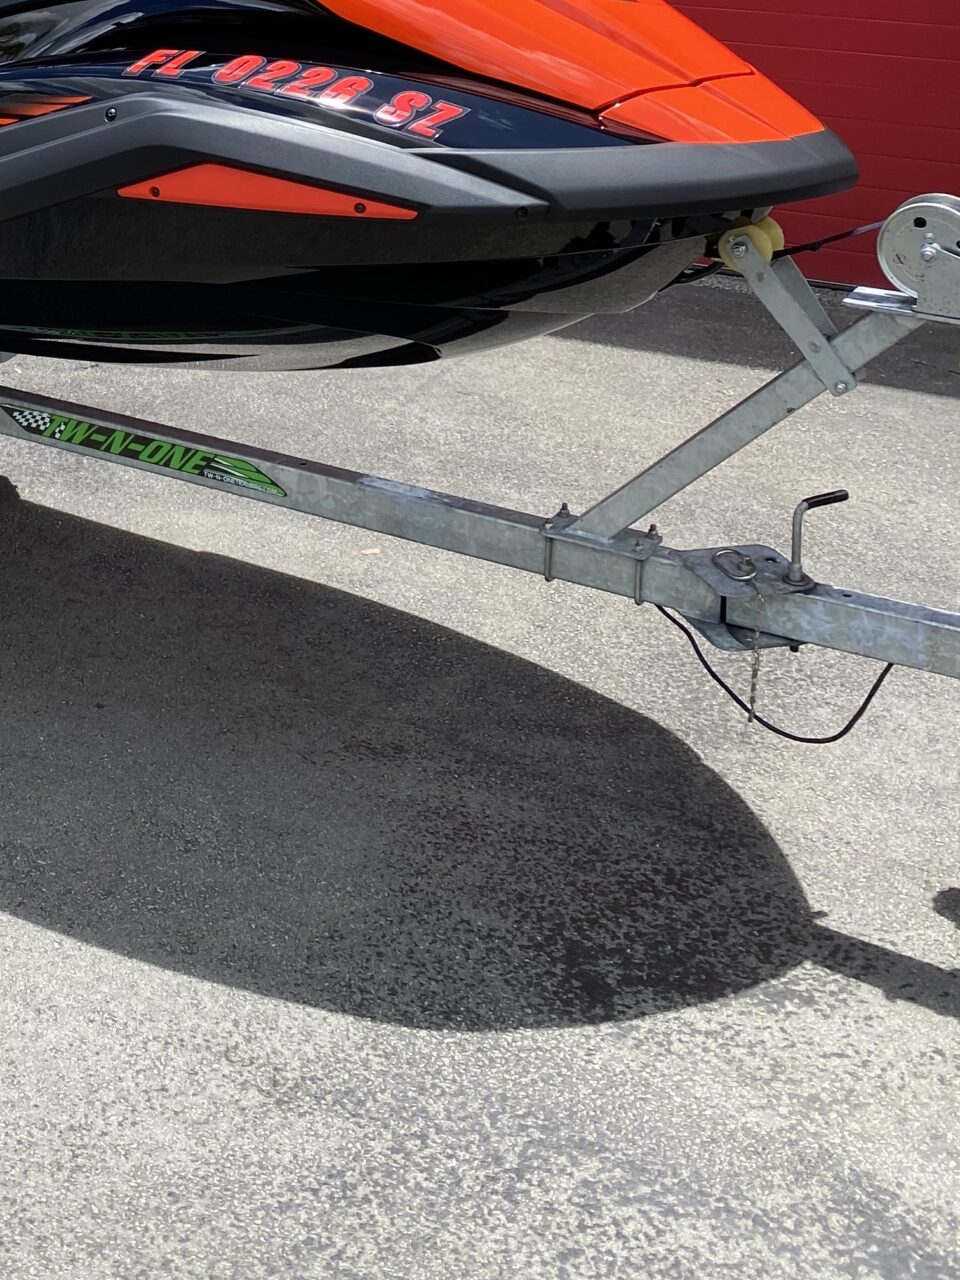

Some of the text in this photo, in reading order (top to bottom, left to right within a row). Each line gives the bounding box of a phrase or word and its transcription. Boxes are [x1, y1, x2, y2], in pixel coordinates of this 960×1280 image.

[122, 49, 206, 78] FL
[373, 90, 471, 141] SZ
[42, 415, 218, 475] TW-N-ONE
